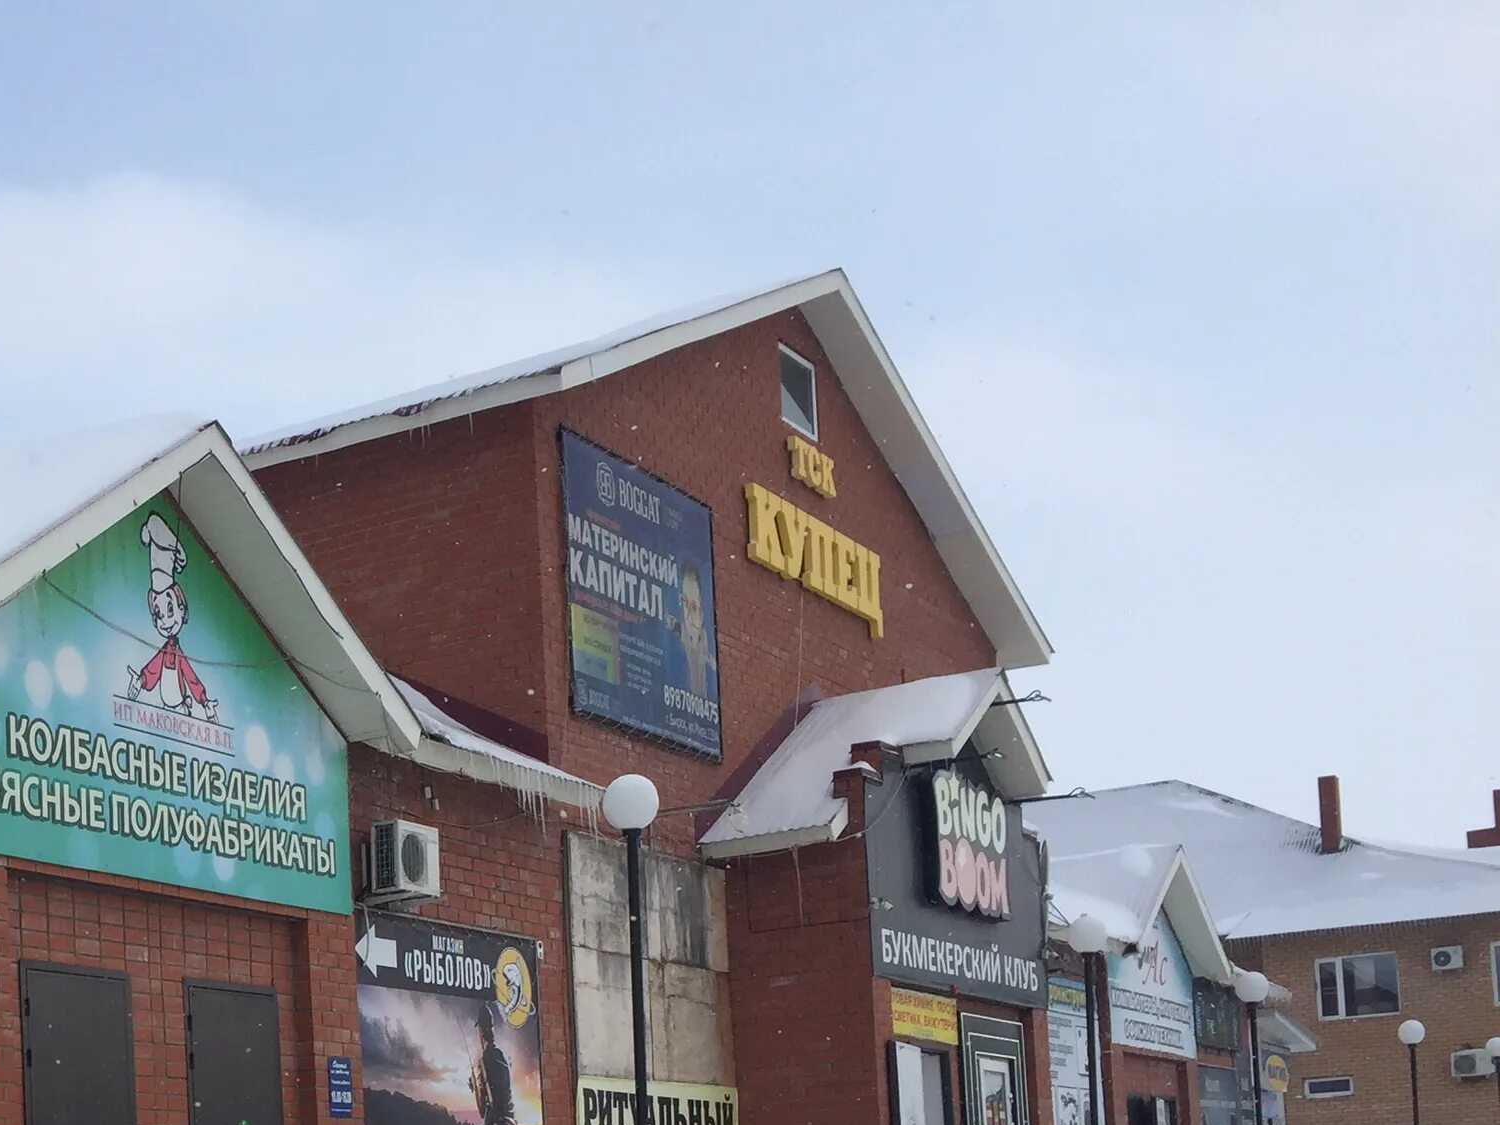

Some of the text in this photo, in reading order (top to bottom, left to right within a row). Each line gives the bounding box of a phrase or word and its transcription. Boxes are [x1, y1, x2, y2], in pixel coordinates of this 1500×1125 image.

[618, 479, 660, 524] BOGGAT
[787, 435, 836, 499] ТСК
[568, 512, 679, 588] МАТЕРИНСКИЙ
[570, 547, 662, 621] КАПИТАЛ
[745, 482, 884, 639] КУПЕЦ
[137, 709, 211, 741] МАКОВСКАЯ
[7, 712, 307, 823] КОЛБАСНЫЕ ИЗДЕЛИЯ
[109, 791, 337, 877] ПОЛУФАБРИКАТЫ
[939, 838, 1010, 914] BOOM
[405, 948, 491, 990] «РЫБОЛОВ»
[432, 934, 464, 956] МАГАЗИН
[881, 928, 1039, 991] БУКМЕКЕРСКИЙ КЛУБ
